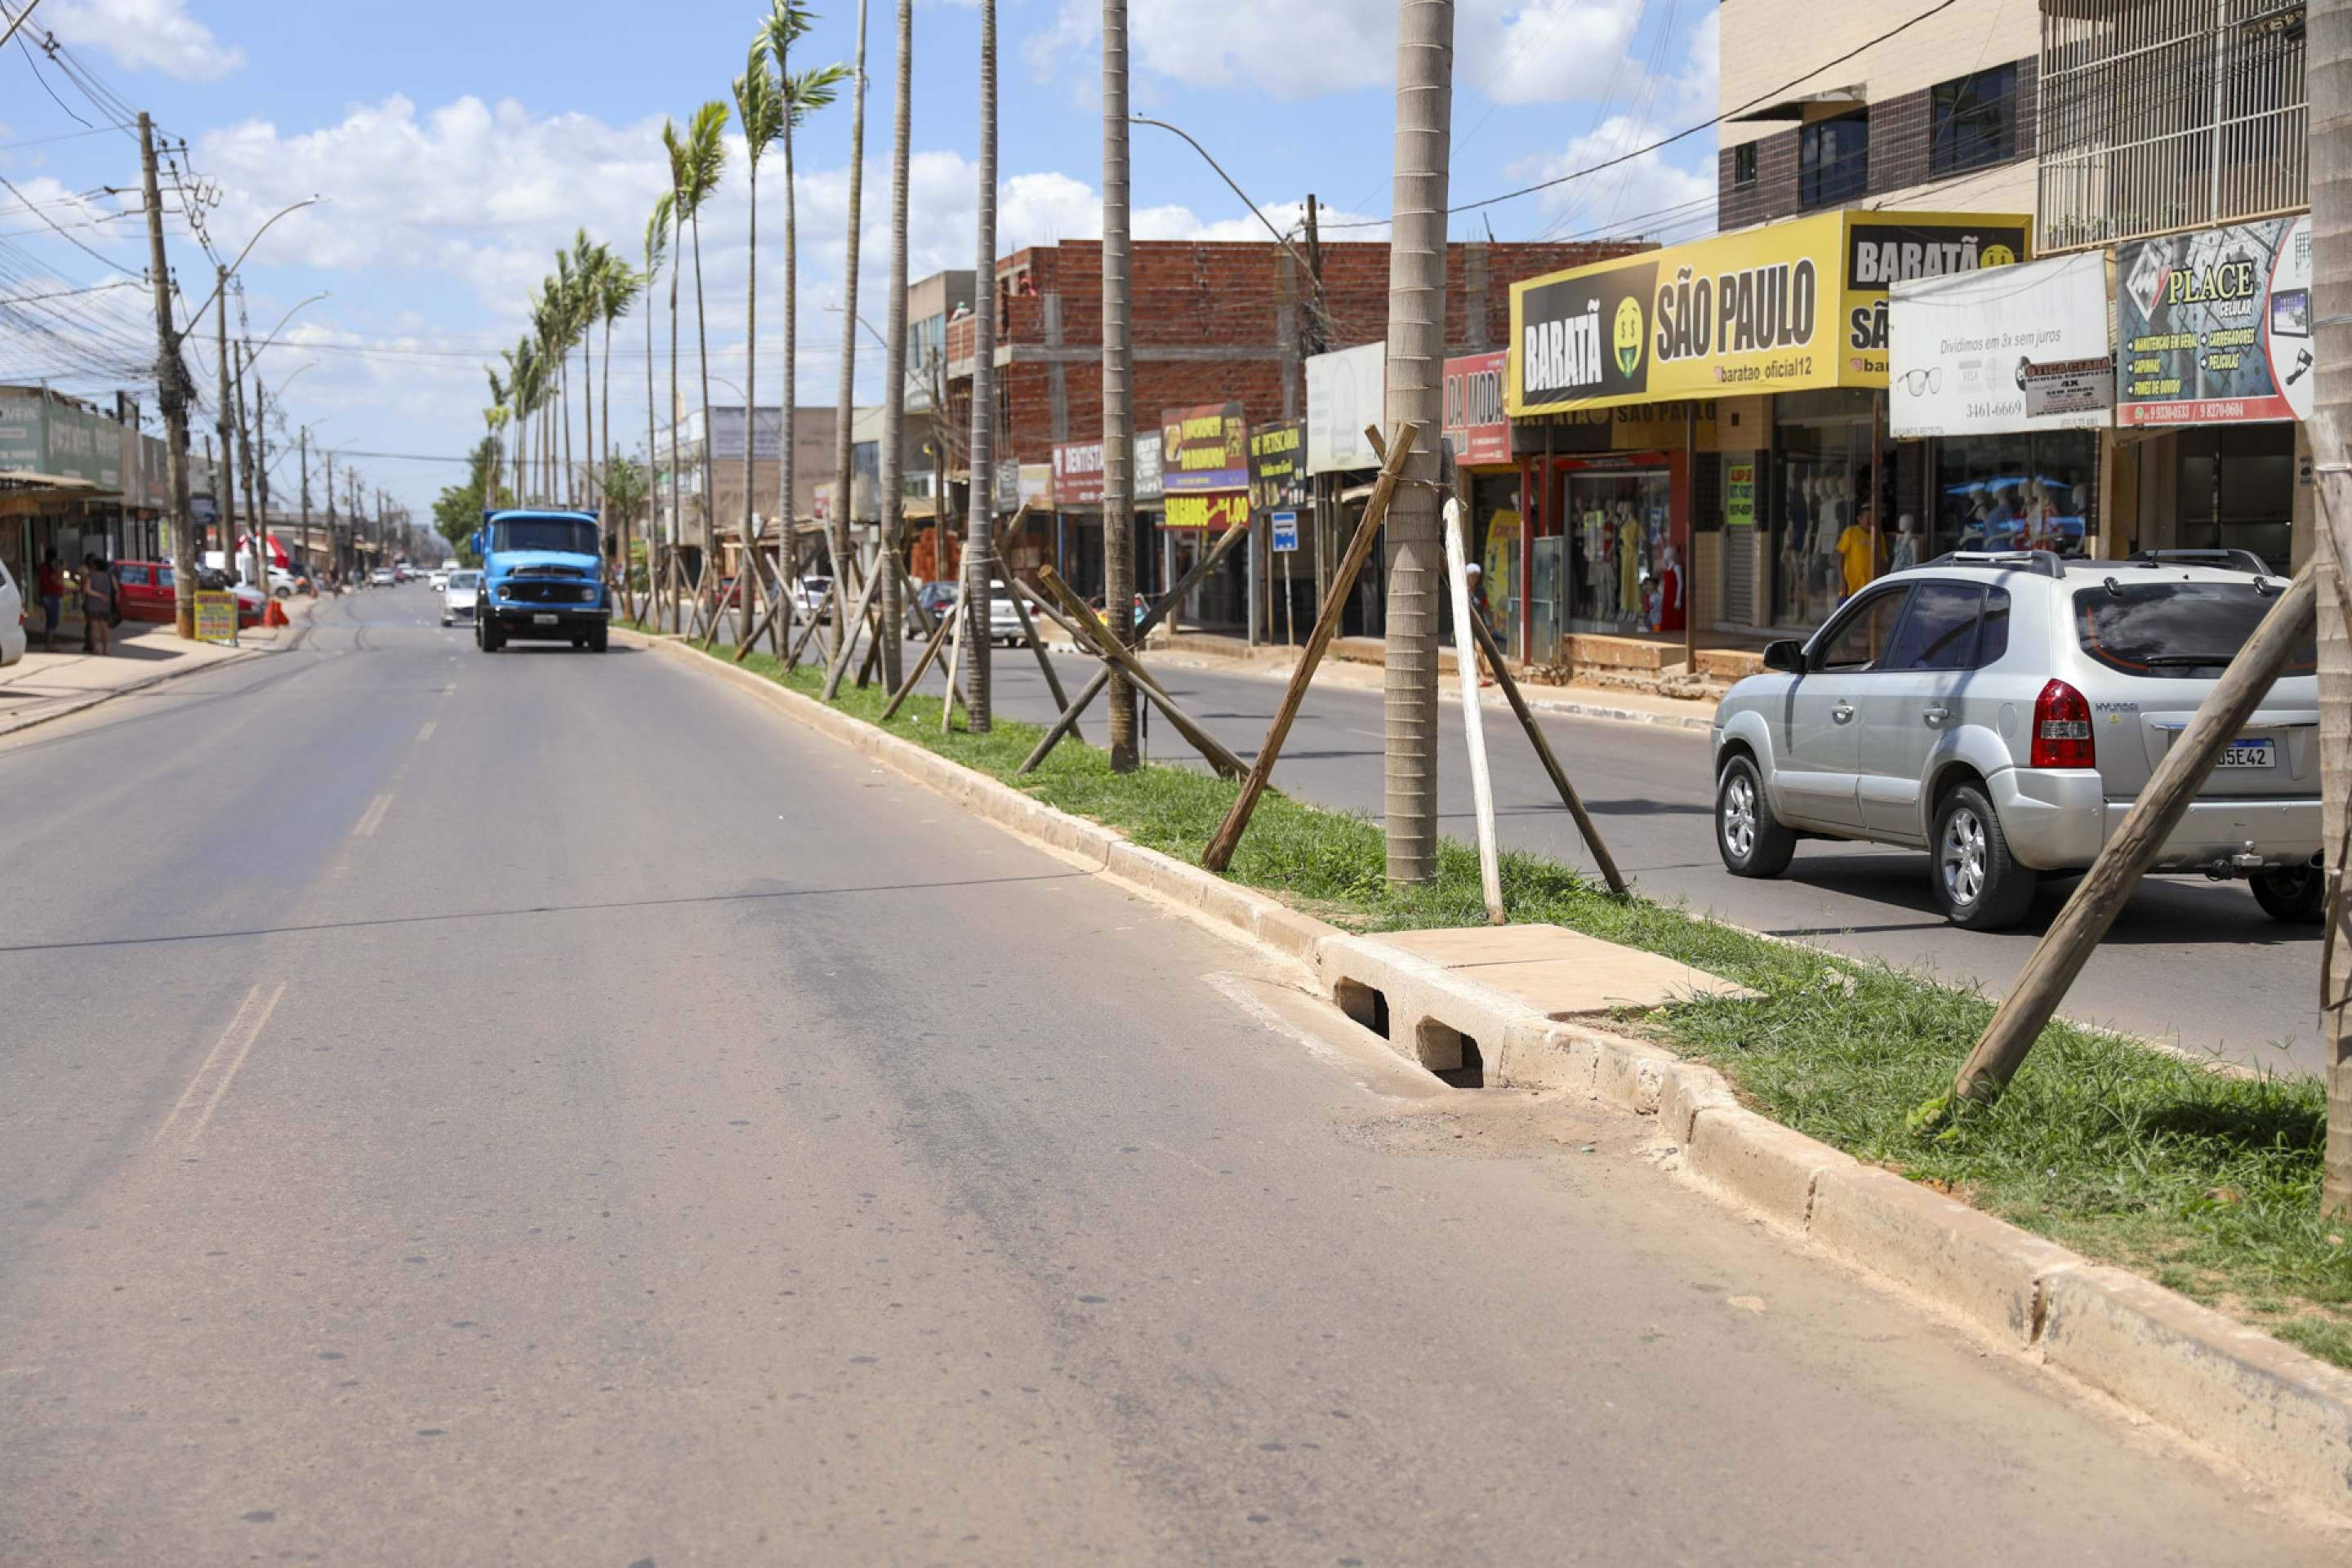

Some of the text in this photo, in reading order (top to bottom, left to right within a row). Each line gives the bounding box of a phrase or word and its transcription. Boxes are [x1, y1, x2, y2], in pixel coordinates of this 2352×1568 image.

[2168, 261, 2254, 305] PLACE
[1656, 257, 1815, 362] SÃO PAULO
[2220, 299, 2252, 316] CELULAR
[1940, 329, 2061, 354] Dividimos em 3x sem juros
[1448, 370, 1504, 428] DA MODA
[1966, 401, 2022, 419] 3461-6669
[2096, 702, 2139, 712] HYUNDAI
